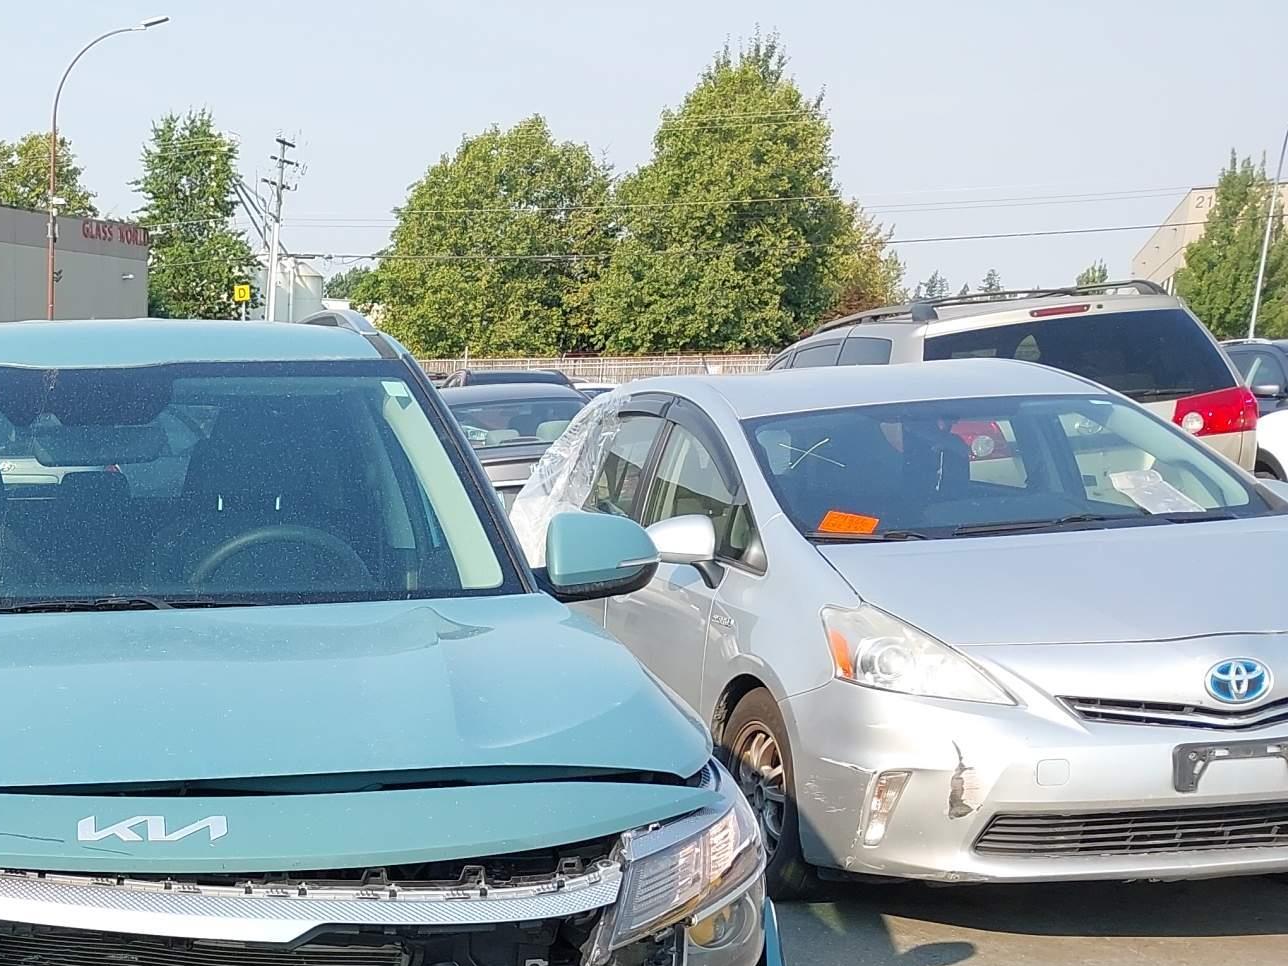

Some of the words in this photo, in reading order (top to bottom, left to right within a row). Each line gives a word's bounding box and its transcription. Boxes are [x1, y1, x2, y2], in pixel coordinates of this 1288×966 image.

[82, 221, 113, 242] GLASS
[119, 226, 149, 246] WORLD
[238, 287, 246, 299] D
[77, 814, 228, 842] KIA
